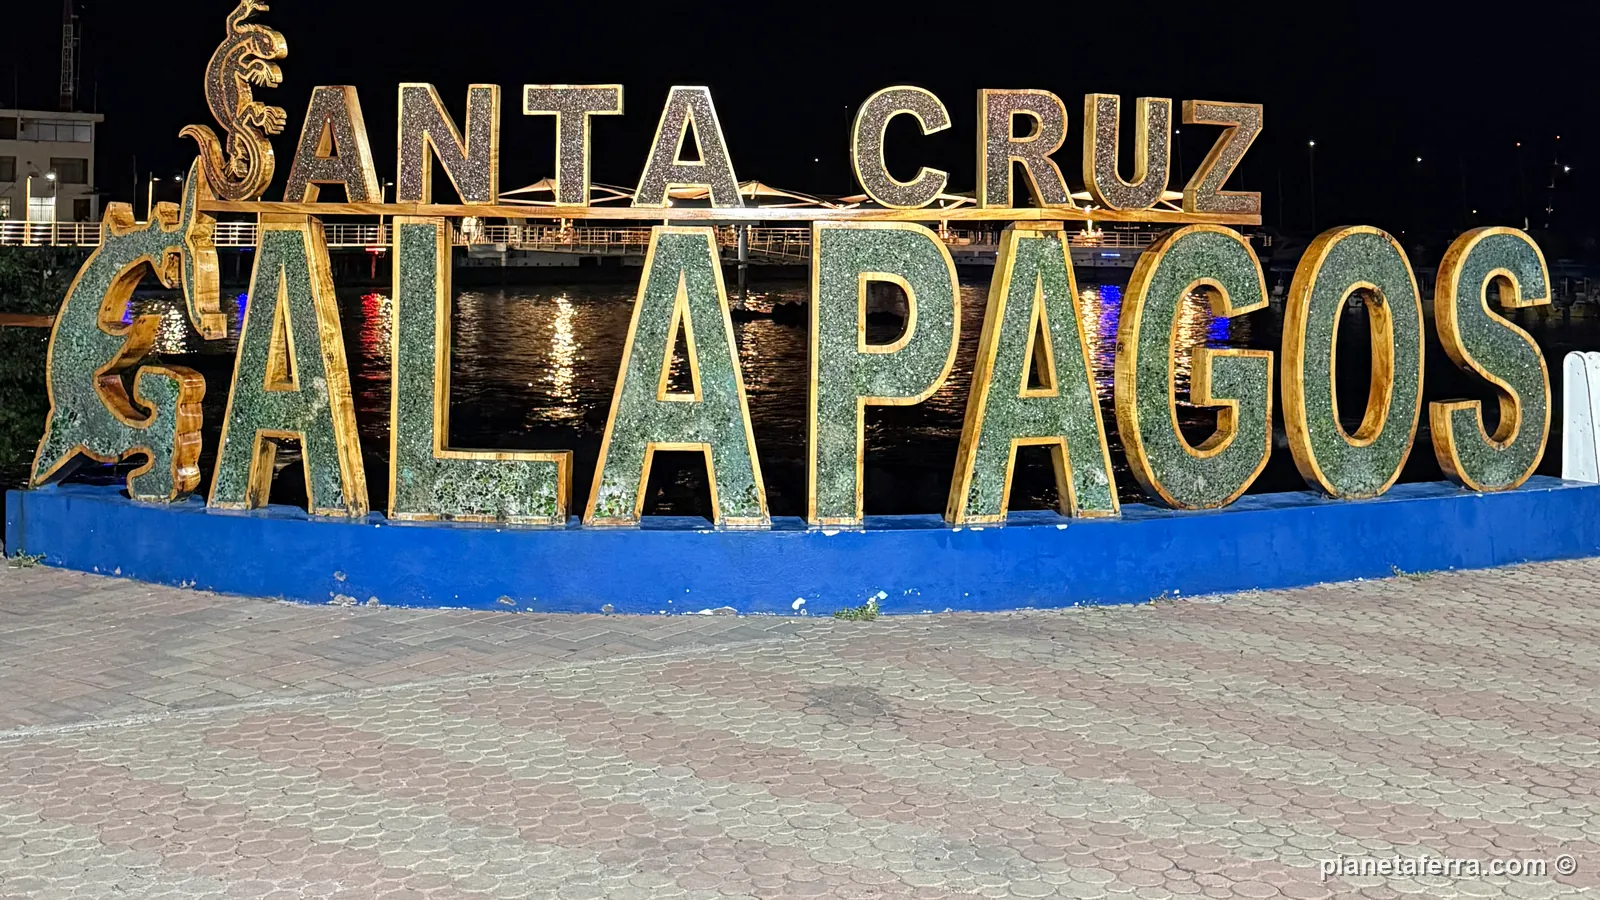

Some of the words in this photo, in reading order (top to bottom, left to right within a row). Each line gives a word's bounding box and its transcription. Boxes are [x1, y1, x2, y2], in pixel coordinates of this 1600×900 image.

[179, 0, 745, 208] SANTA
[850, 85, 1263, 212] CRUZ
[29, 165, 1552, 529] GALAPAGOS
